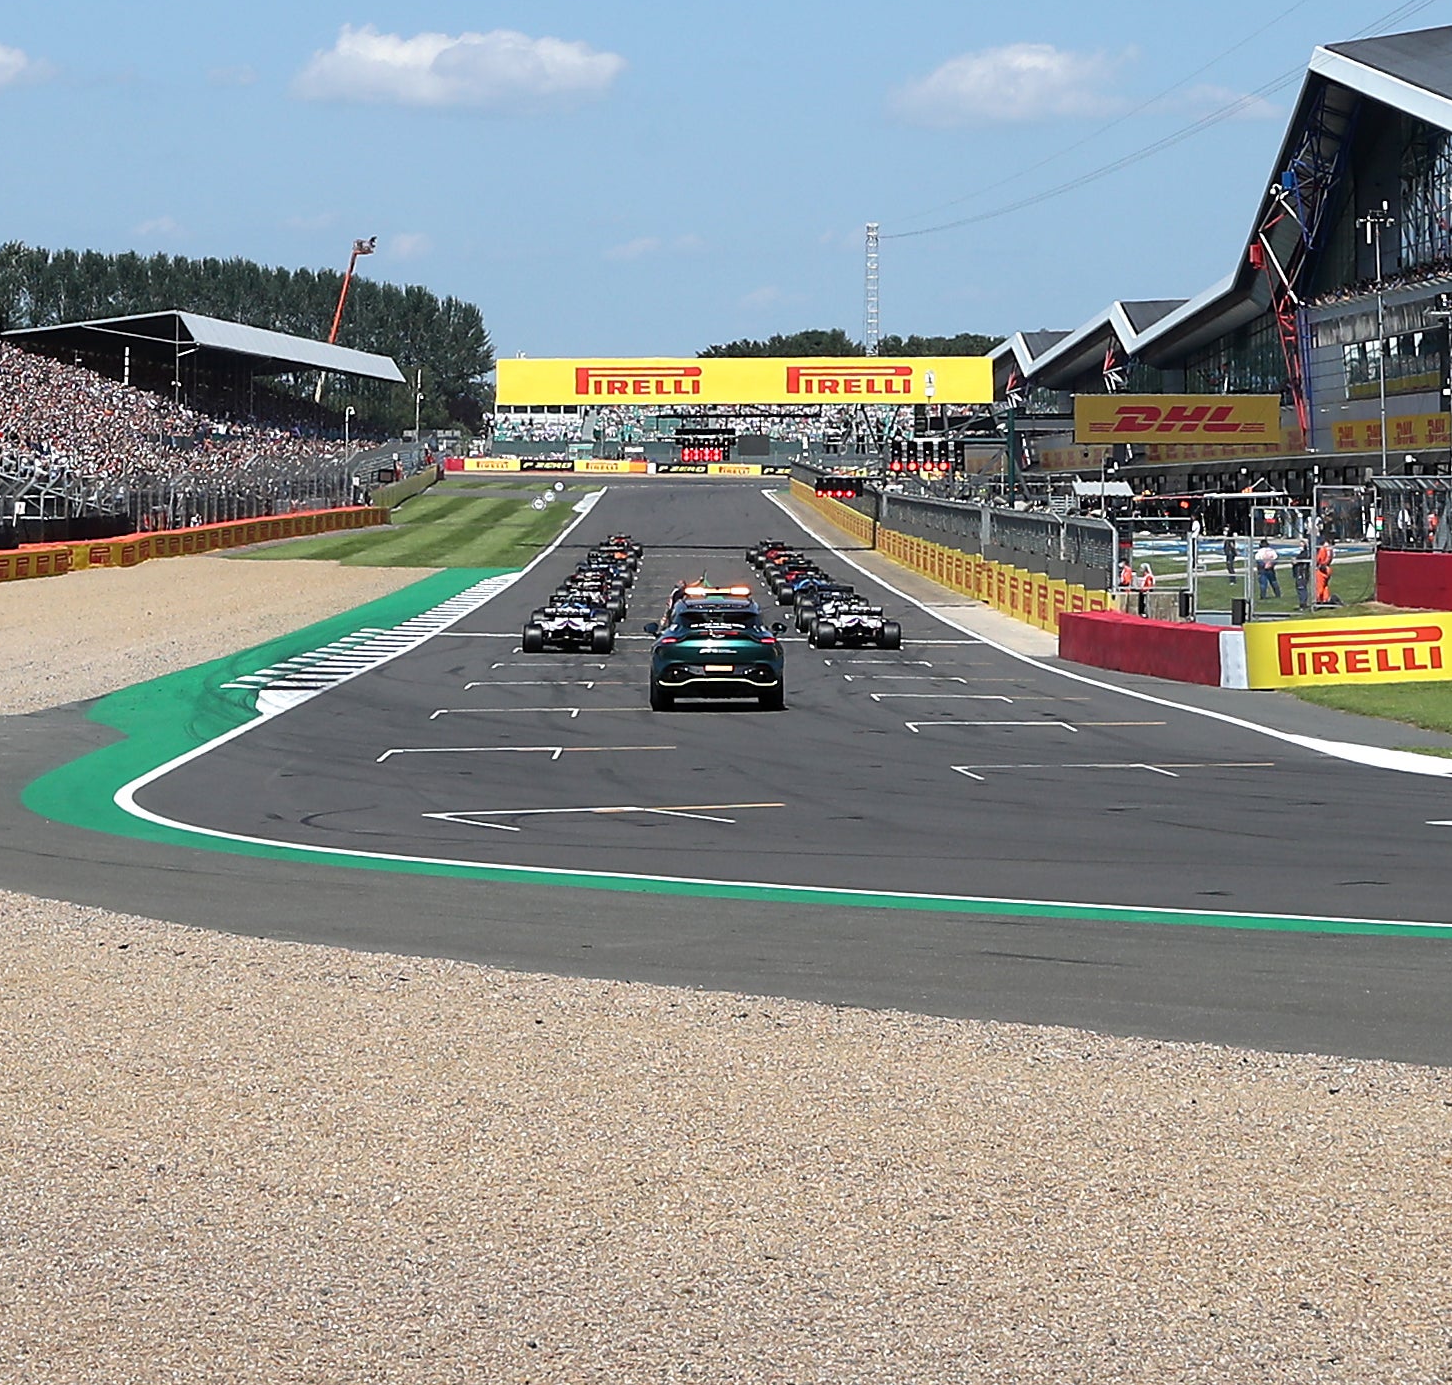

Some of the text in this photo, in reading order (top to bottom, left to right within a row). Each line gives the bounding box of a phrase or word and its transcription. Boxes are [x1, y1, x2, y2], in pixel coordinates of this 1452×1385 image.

[576, 366, 913, 395] PIRELLI PIRELLI
[1112, 406, 1245, 432] DHL
[1277, 625, 1443, 676] PIRELLI
